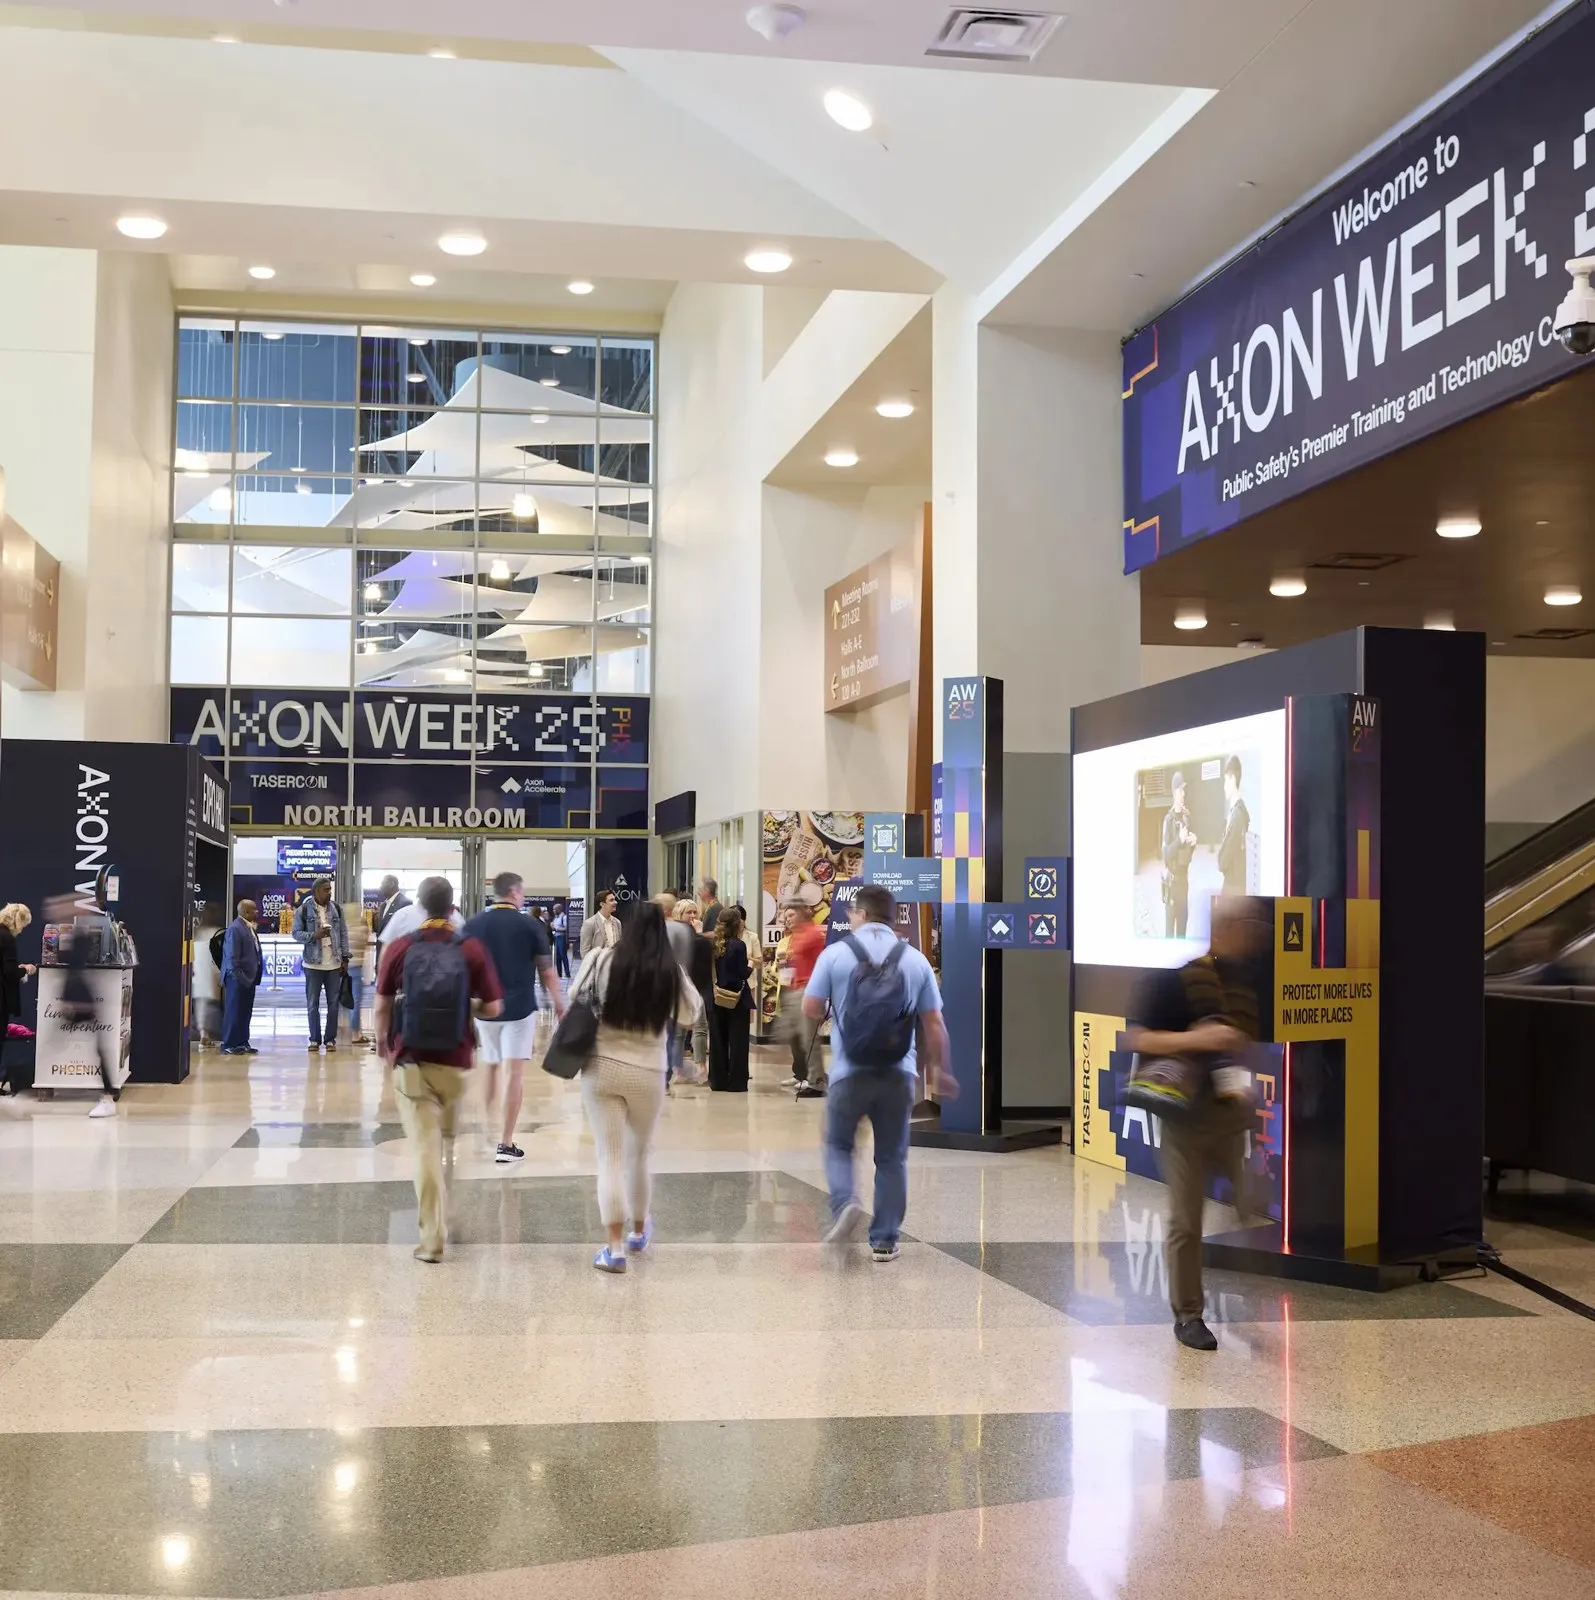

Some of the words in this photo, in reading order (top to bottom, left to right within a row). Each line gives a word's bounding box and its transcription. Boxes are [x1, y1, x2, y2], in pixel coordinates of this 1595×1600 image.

[1332, 153, 1429, 246] Welcome
[1433, 134, 1460, 175] to
[1177, 288, 1322, 475] AXON
[1333, 140, 1548, 382] WEEK
[1222, 466, 1254, 502] Public
[1255, 443, 1300, 490] Safety's
[1301, 421, 1350, 463] Premier
[1351, 394, 1406, 440] Training
[1407, 374, 1436, 410] and
[1439, 329, 1535, 397] Technology
[840, 660, 856, 679] North
[948, 684, 977, 701] AW
[948, 701, 975, 720] 25
[1352, 700, 1377, 727] AW
[190, 698, 349, 749] AXON
[363, 701, 520, 753] WEEK
[535, 706, 607, 753] 25
[250, 775, 327, 788] TASERCON
[524, 778, 545, 786] Axon
[524, 785, 566, 793] Accelerate
[74, 763, 111, 870] AXON
[284, 804, 373, 827] NORTH
[383, 806, 526, 829] BALLROOM
[286, 849, 331, 857] REGISTRATION
[612, 889, 641, 901] XON
[1282, 983, 1322, 1001] PROTECT
[1323, 983, 1348, 1000] MORE
[1349, 982, 1373, 999] LIVES
[1282, 1008, 1292, 1025] IN
[1293, 1008, 1319, 1025] MORE
[1320, 1006, 1353, 1024] PLACES
[60, 1019, 114, 1034] adventure
[51, 1064, 102, 1076] PHOENIX
[1082, 1022, 1091, 1148] TASERCON
